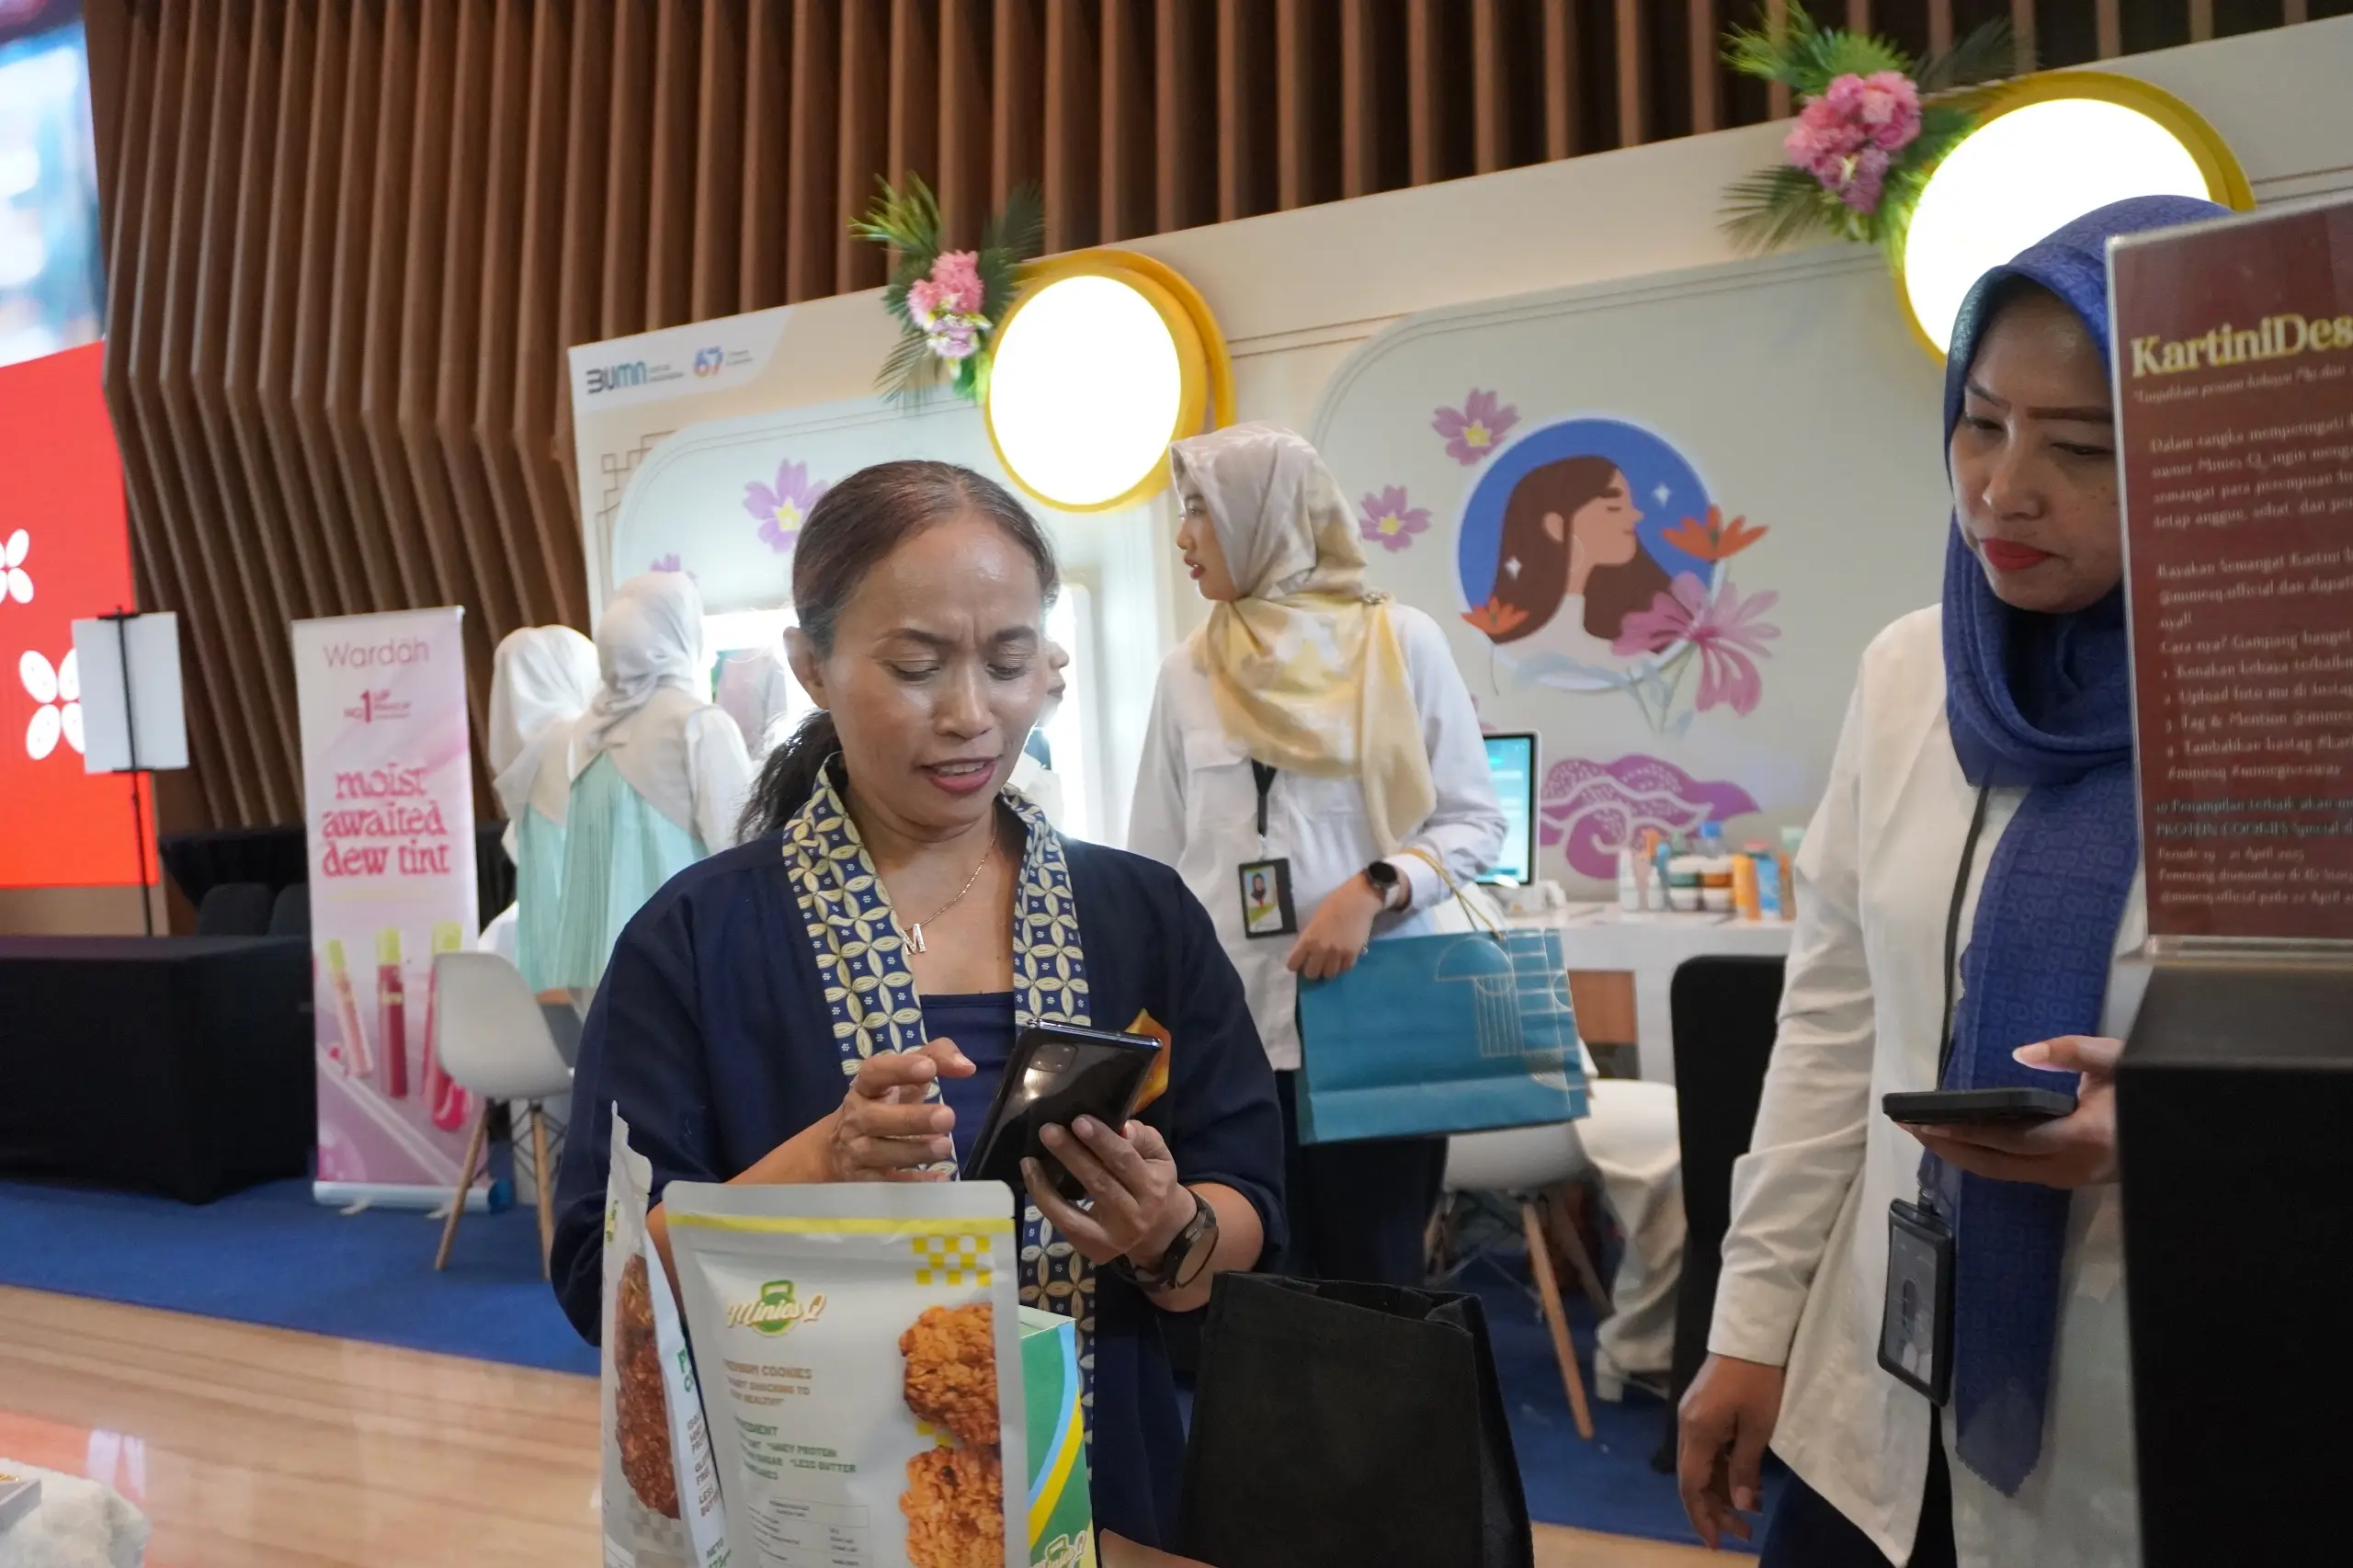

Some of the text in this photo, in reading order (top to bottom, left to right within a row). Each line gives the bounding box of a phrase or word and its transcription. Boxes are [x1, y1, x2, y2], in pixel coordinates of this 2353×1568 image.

[693, 346, 723, 379] 67
[323, 637, 430, 668] Wardah
[335, 762, 427, 800] moist
[322, 800, 448, 838] awaited
[322, 838, 452, 878] dew tint
[761, 1365, 813, 1380] COOKIES
[797, 1385, 811, 1396] TO
[797, 1446, 837, 1458] PROTEIN
[818, 1461, 857, 1473] BUTTER
